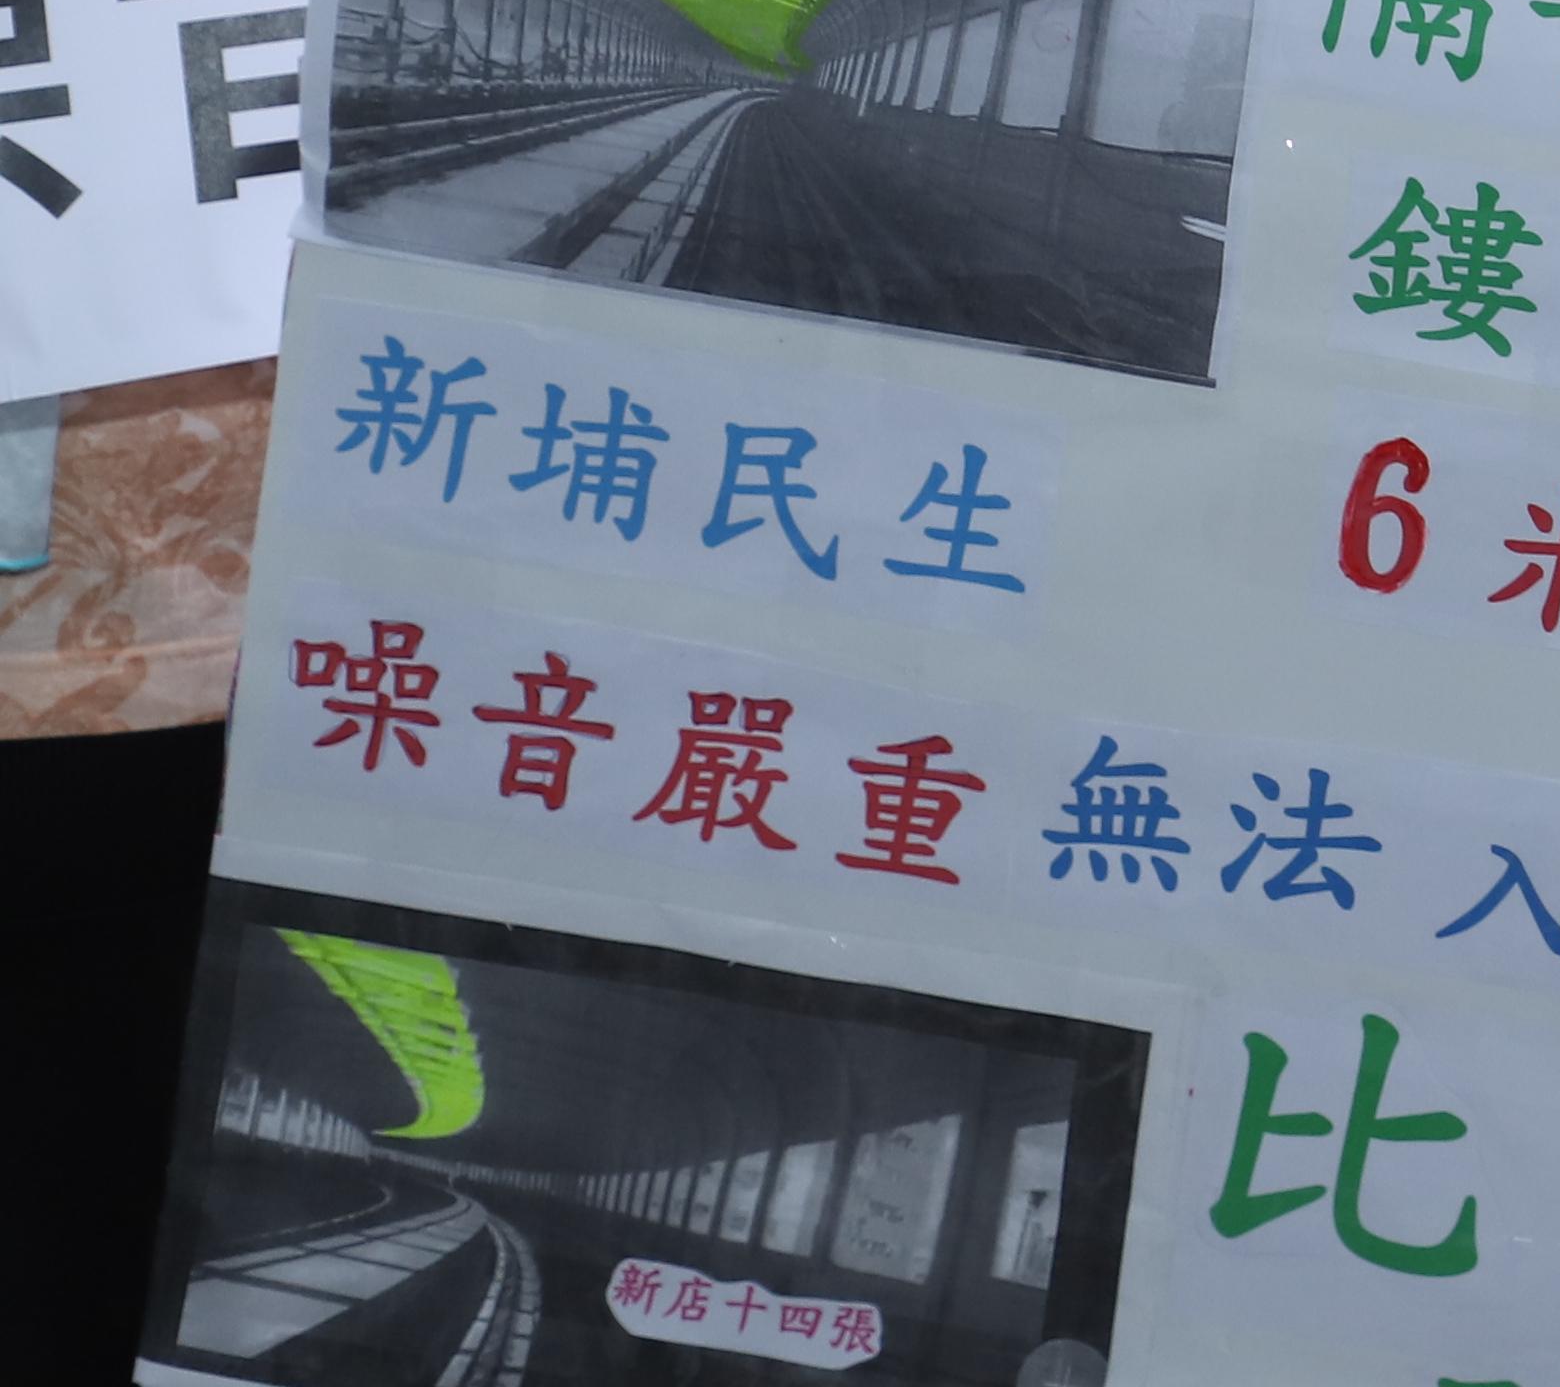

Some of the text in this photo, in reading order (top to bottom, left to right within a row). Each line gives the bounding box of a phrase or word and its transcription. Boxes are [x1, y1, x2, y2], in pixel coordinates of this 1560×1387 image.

[335, 334, 1027, 596] 新埔民生
[1209, 1012, 1480, 1278] 比
[613, 1263, 876, 1354] 新店十四張
